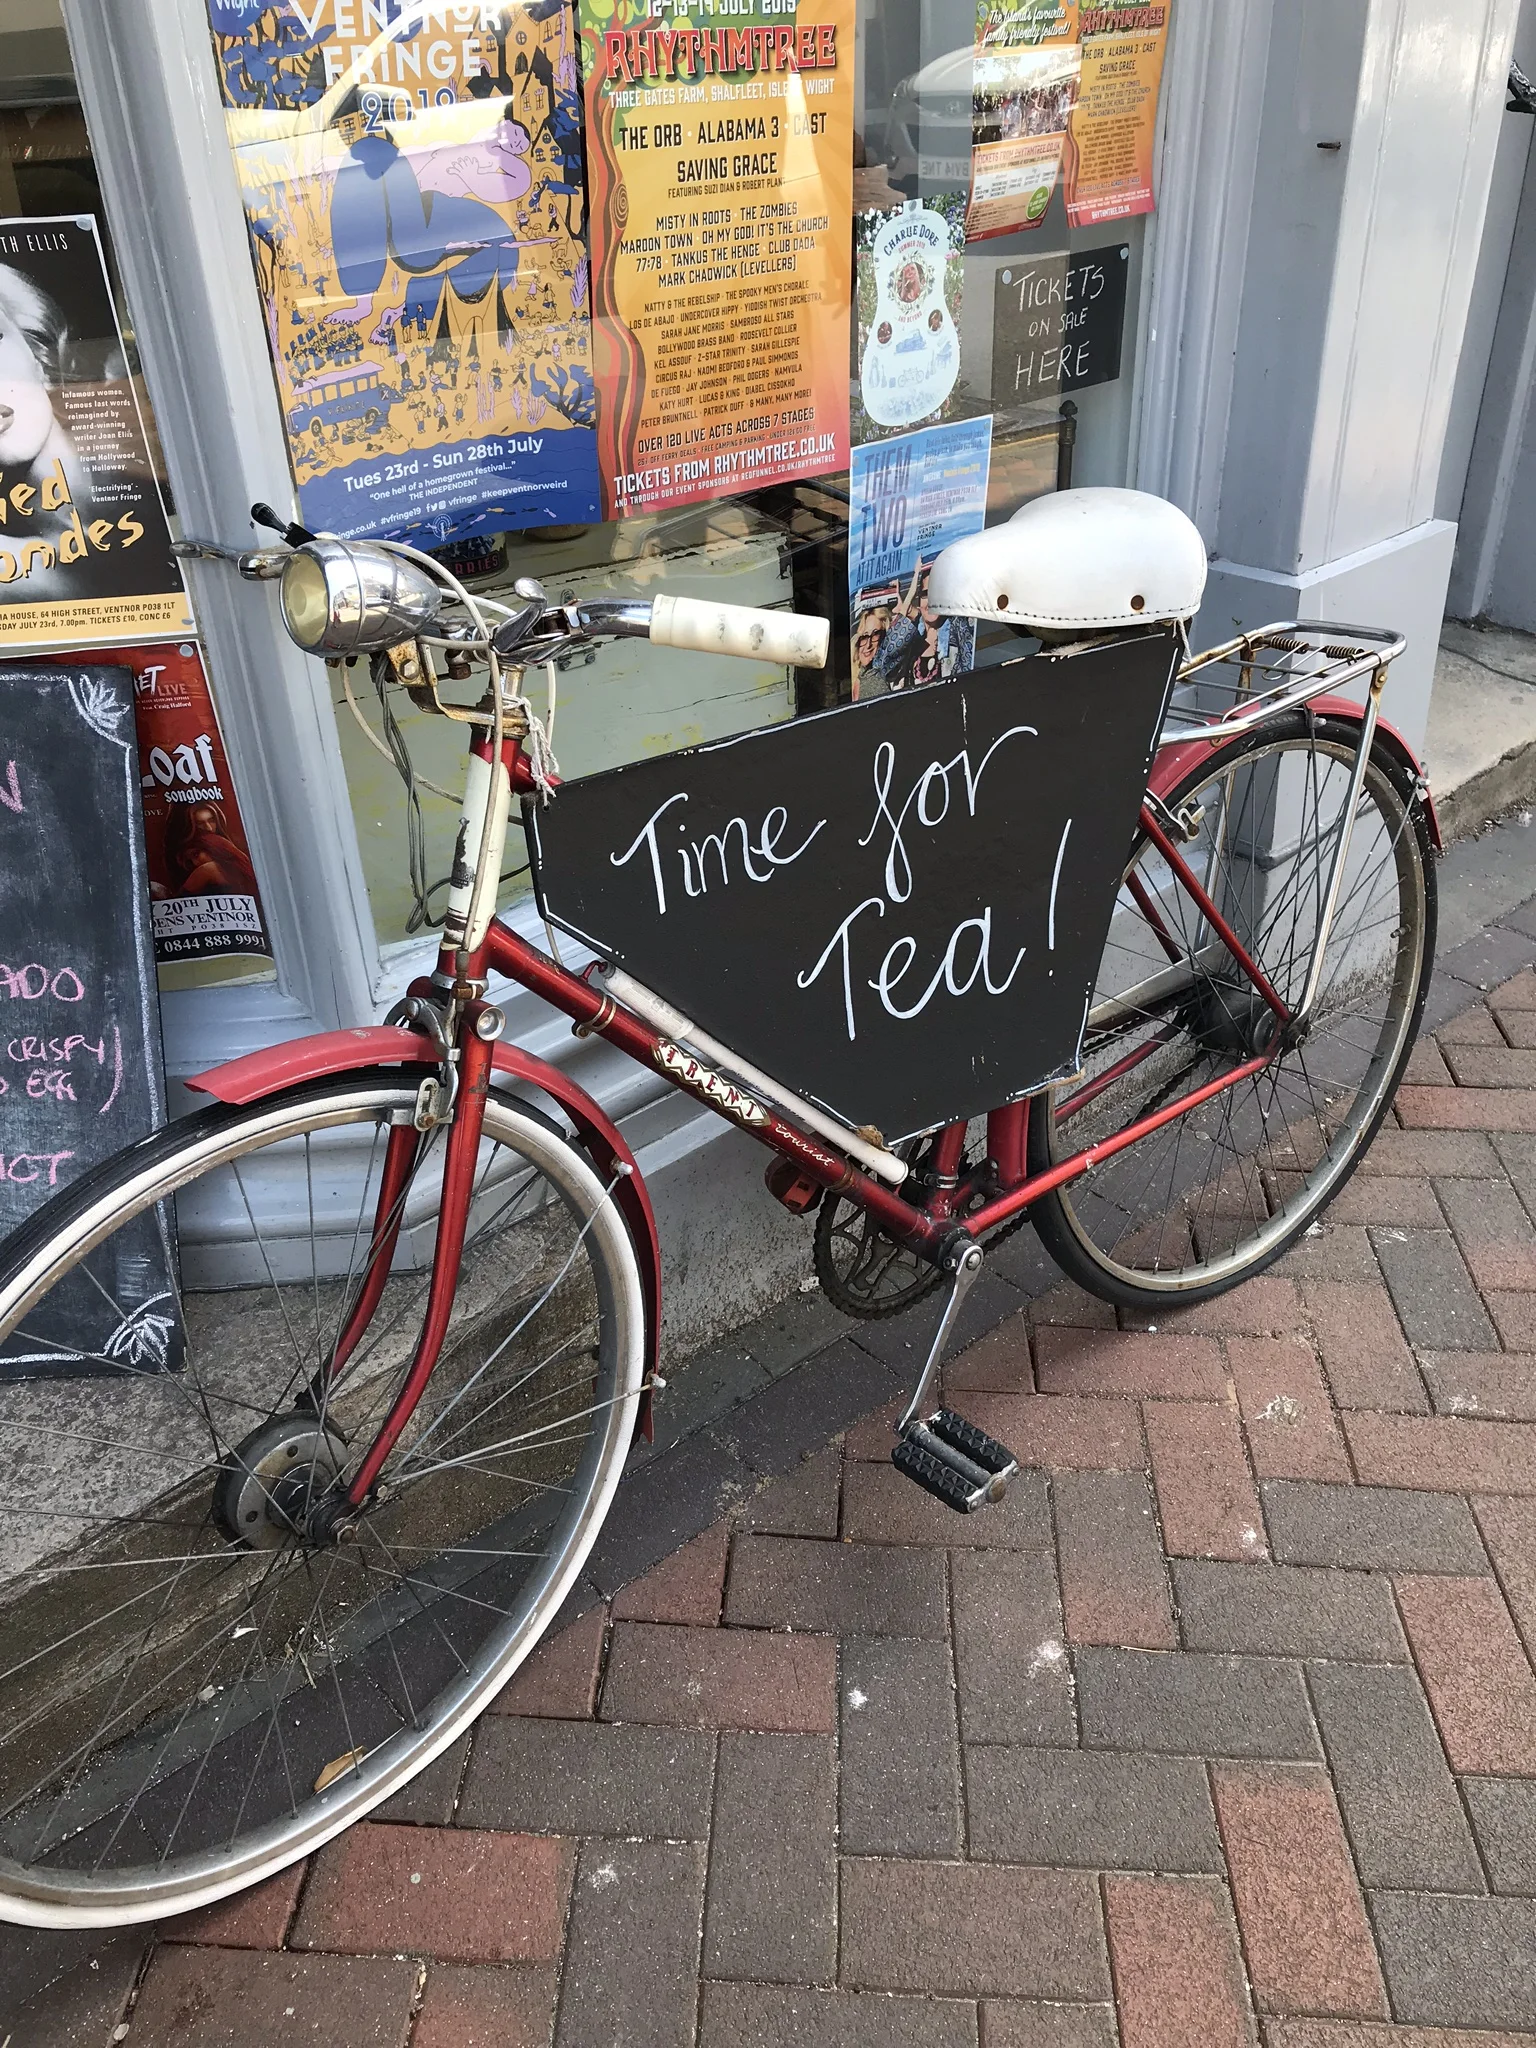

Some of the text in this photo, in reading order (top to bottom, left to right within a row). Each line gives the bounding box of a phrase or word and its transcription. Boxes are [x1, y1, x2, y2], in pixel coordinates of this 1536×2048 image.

[720, 0, 754, 15] JULY
[989, 10, 1003, 24] The
[1032, 8, 1065, 26] favourite
[1083, 6, 1165, 34] RHYTHMTREE
[983, 27, 1008, 48] family
[1009, 24, 1039, 45] friendly
[604, 24, 836, 83] RHYTHMTREE
[609, 90, 642, 109] THREE
[645, 89, 675, 107] GATES
[678, 86, 708, 104] FARM,
[712, 83, 766, 102] SHALFLEET,
[806, 78, 835, 95] WIGHT
[620, 113, 827, 150] THE ORB ALABAMA 3 CAST
[678, 152, 778, 183] SAVING GRACE
[656, 202, 798, 231] MISTY IN ROOTS THE ZOMBIES
[0, 233, 68, 253] TH ELLIS
[620, 216, 829, 255] MAROON TOWN OH MY GOD! IT'S THE CHURCH
[919, 224, 940, 247] DORE
[1013, 265, 1104, 312] TICKETS
[1029, 307, 1088, 337] ON SALE
[1015, 341, 1090, 390] HERE
[62, 390, 95, 398] Infamous
[68, 411, 108, 420] reimagined
[72, 422, 125, 430] award-winning
[638, 407, 815, 454] OVER 120 LIVE ACTS ACROSS 7 STAGES
[92, 444, 119, 452] journey
[98, 452, 135, 461] Hollywood
[343, 437, 543, 492] Tues 23rd Sun 28th July
[614, 432, 835, 496] TICKETS FROM RHYTHMTREE.CO.UK
[865, 444, 912, 503] THEM
[392, 485, 407, 495] hell
[408, 482, 416, 491] of
[424, 470, 474, 489] homegrown
[409, 478, 478, 501] THE INDEPENDENT
[92, 495, 118, 503] Ventnor
[380, 508, 421, 525] #vfringe19
[449, 494, 477, 507] vfringe
[481, 480, 568, 499] #keepventnorweird
[860, 494, 907, 560] TWO
[0, 507, 144, 583] ondes
[455, 555, 498, 575] RRIES
[856, 549, 902, 586] AT IT AGAIN
[11, 612, 38, 620] HOUSE,
[52, 609, 70, 617] HIGH
[73, 607, 102, 616] STREET,
[104, 605, 140, 614] VENTNOR
[164, 602, 175, 610] 1LT
[90, 616, 121, 624] TICKETS
[163, 612, 170, 620] £6
[157, 683, 187, 697] LIVE
[164, 785, 224, 804] songbook
[610, 726, 1038, 914] Time for
[162, 899, 200, 916] 20TH
[206, 898, 251, 913] JULY
[186, 912, 256, 924] VENTNOR
[164, 938, 200, 953] 0844
[205, 934, 231, 948] 888
[0, 963, 85, 1001] ADO
[666, 1048, 757, 1118] TRENT
